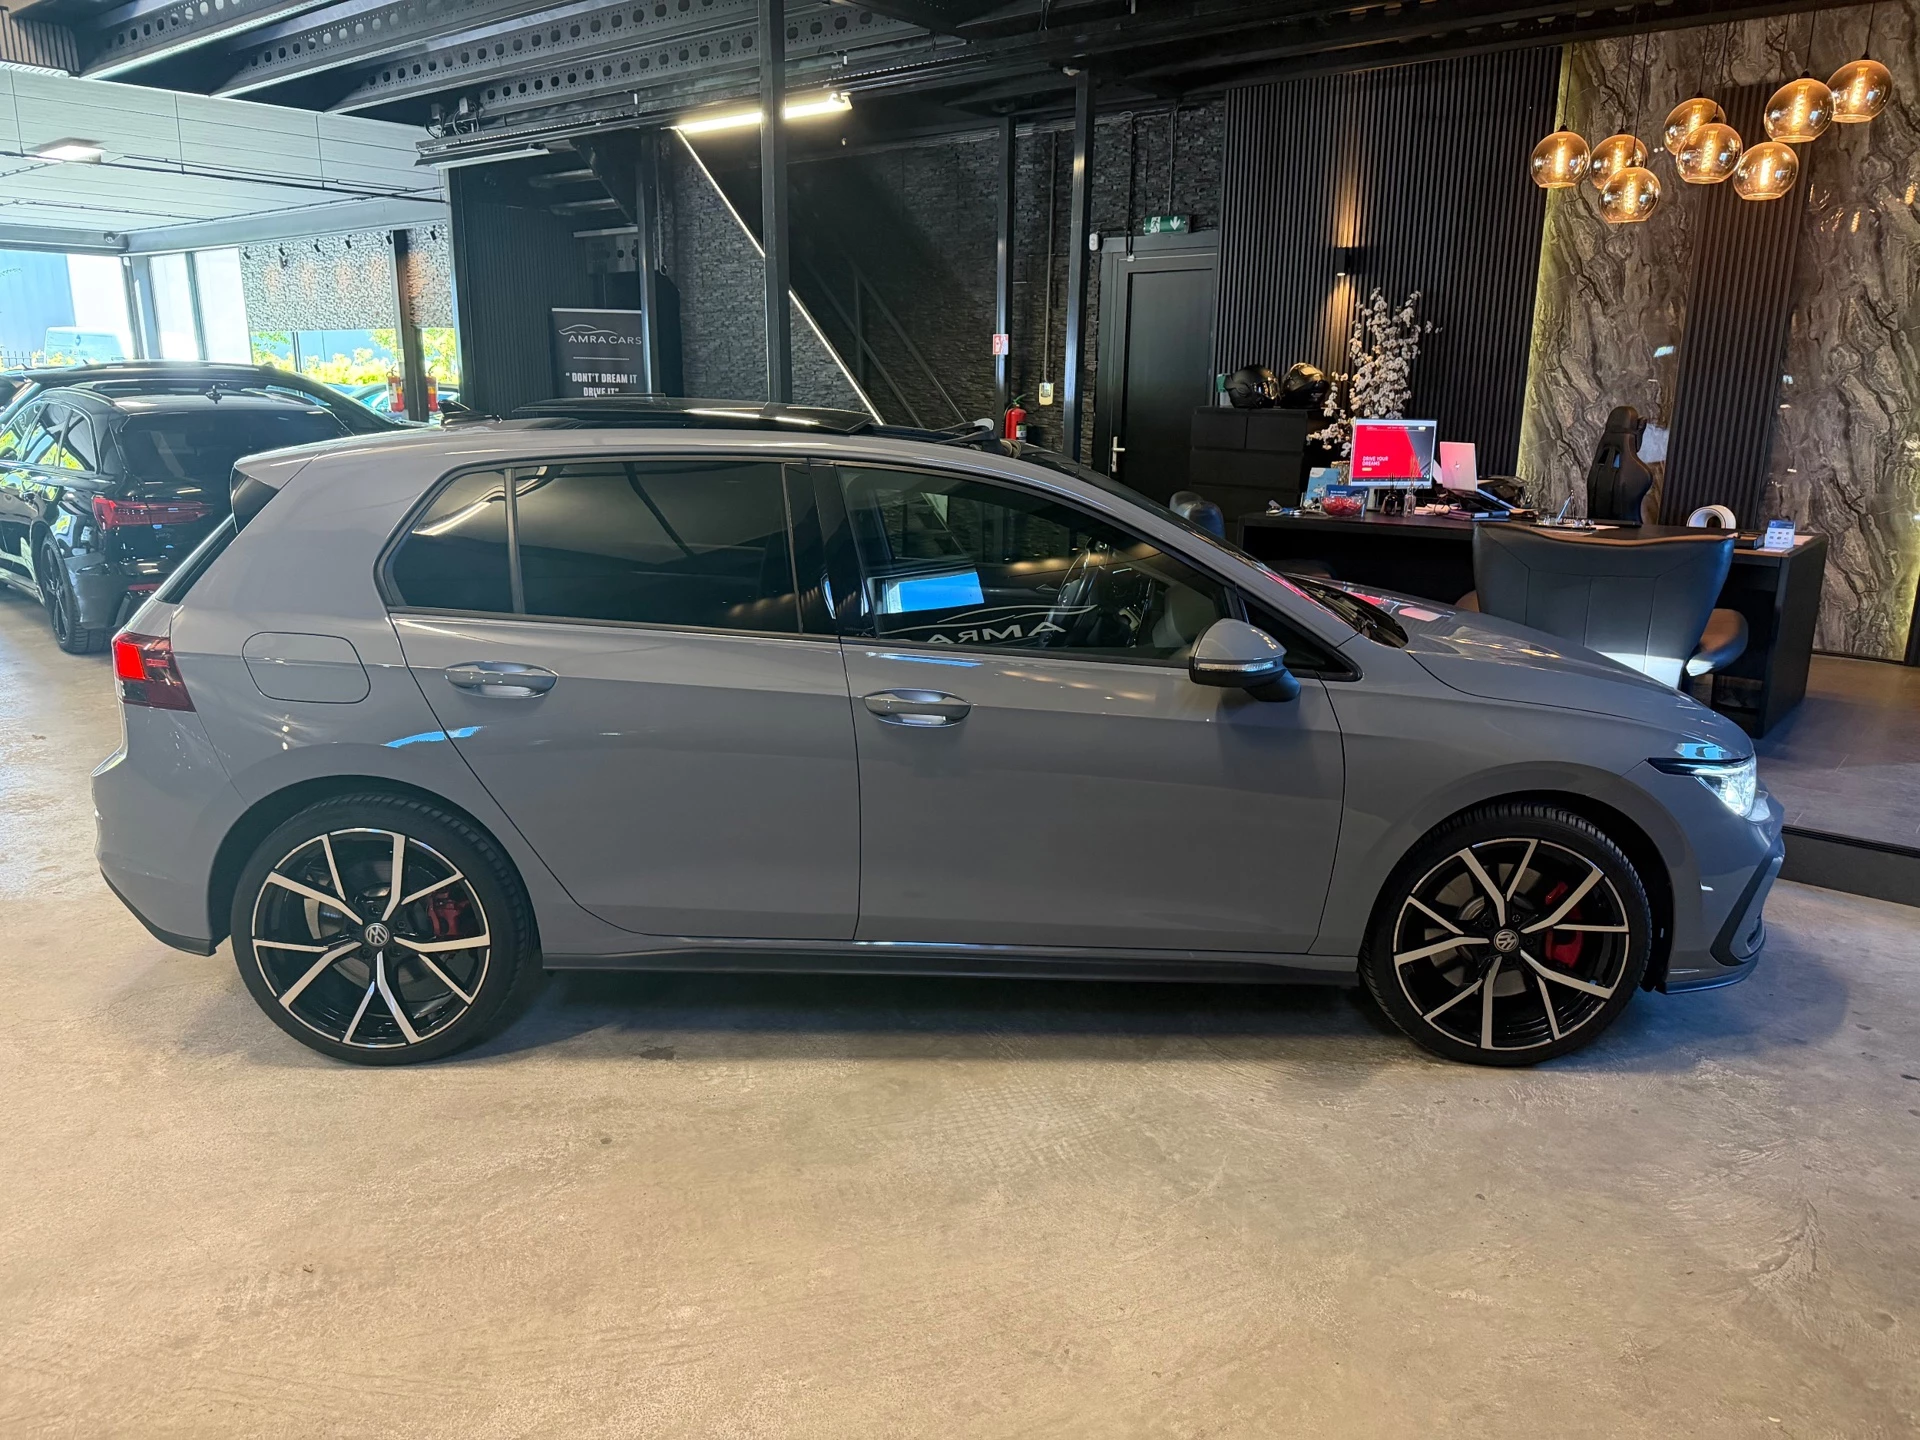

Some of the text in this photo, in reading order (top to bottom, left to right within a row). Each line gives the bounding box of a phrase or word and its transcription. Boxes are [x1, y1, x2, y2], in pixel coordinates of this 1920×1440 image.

[568, 335, 642, 344] AMRA CARS
[601, 373, 628, 384] DREAM
[630, 374, 637, 384] IT
